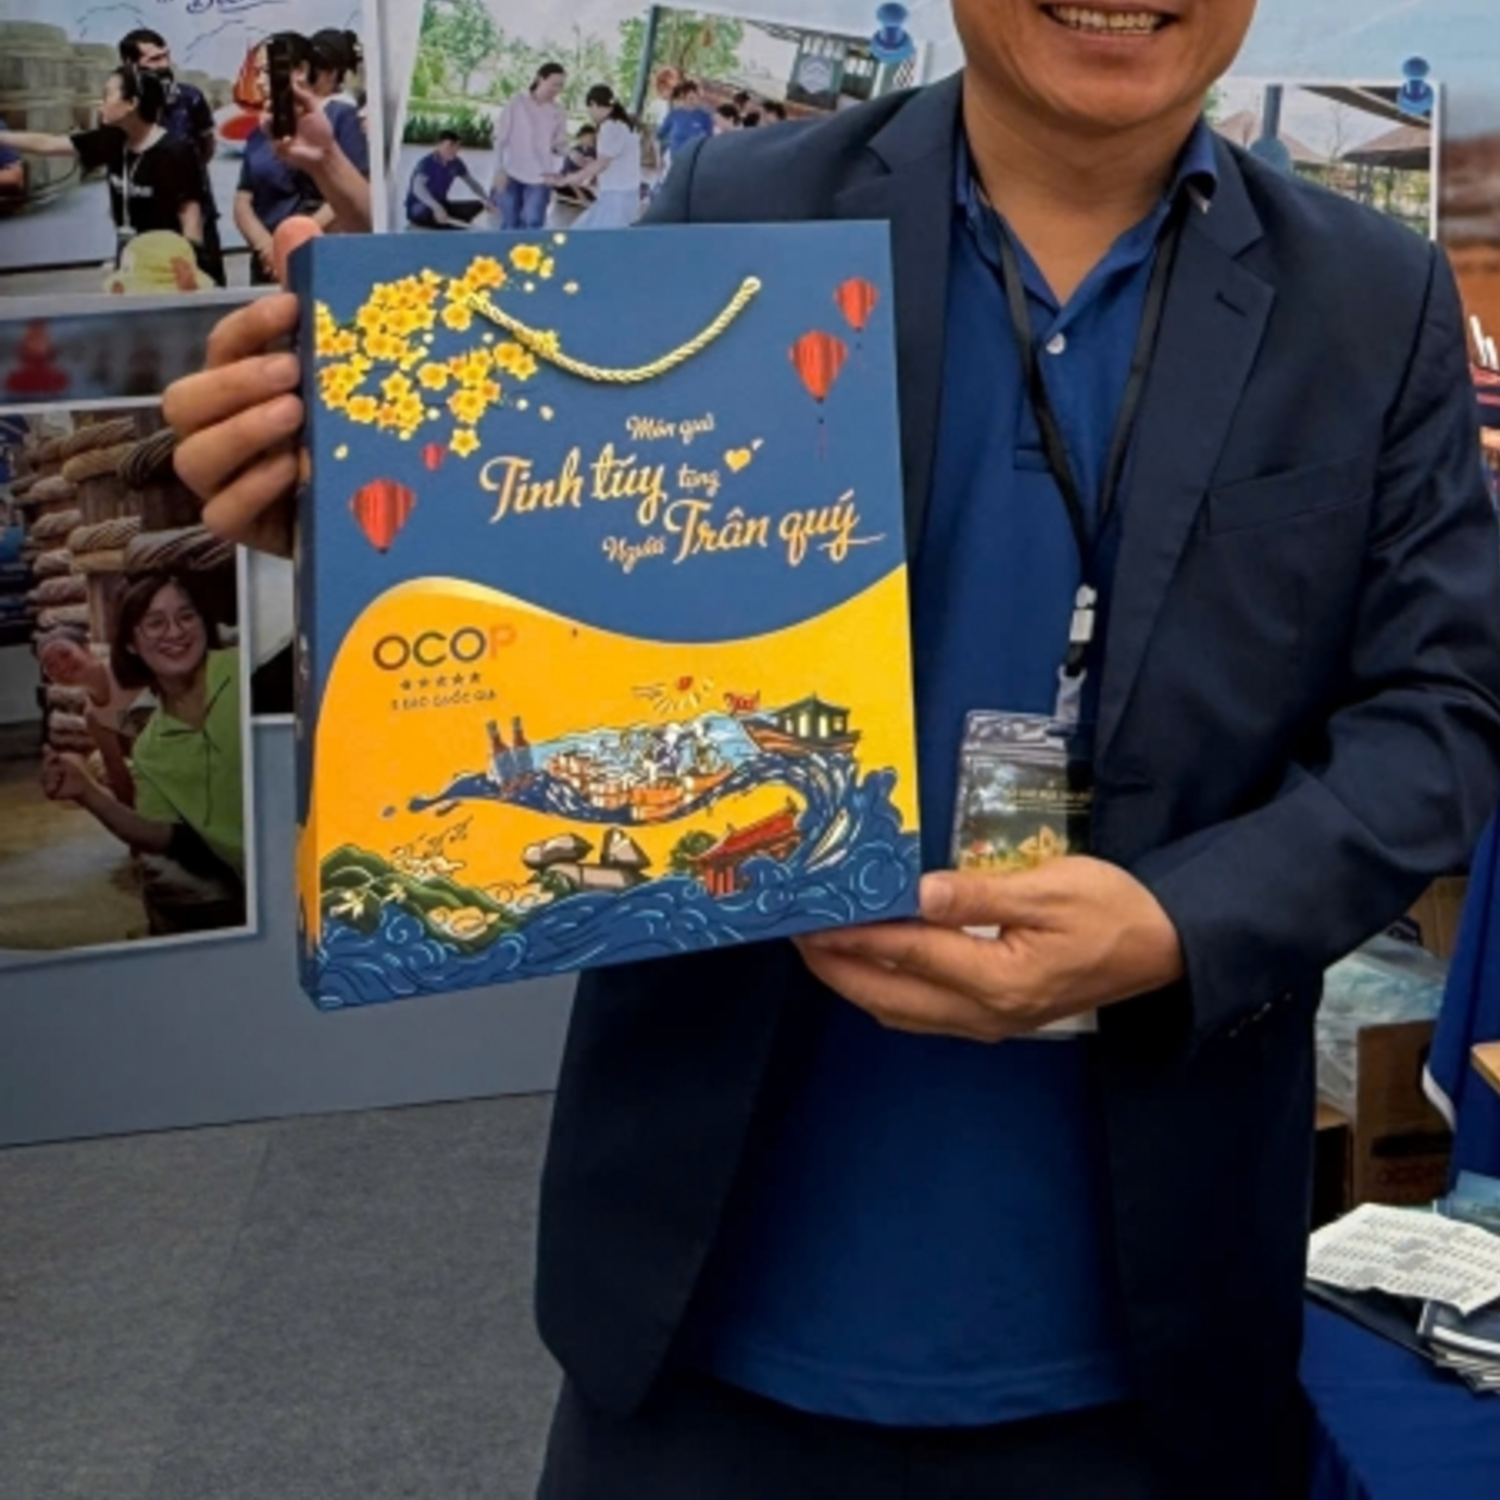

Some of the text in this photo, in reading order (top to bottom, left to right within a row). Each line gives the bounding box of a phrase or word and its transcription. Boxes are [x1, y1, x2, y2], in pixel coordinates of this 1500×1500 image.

[478, 445, 584, 525] Tinh
[590, 442, 669, 526] túy
[662, 498, 771, 566] Trân
[778, 488, 887, 567] quý
[372, 623, 517, 671] OCOP
